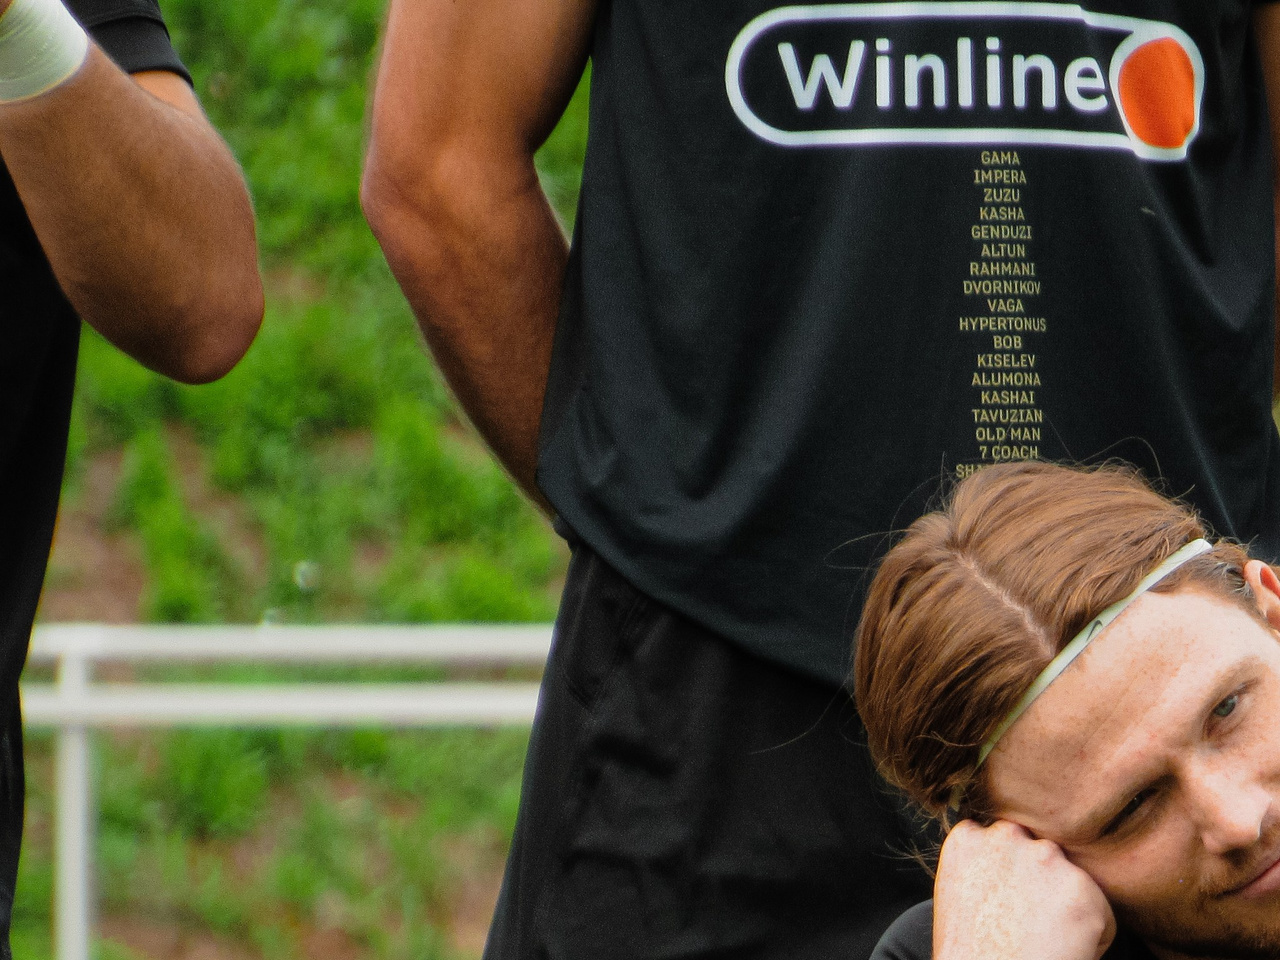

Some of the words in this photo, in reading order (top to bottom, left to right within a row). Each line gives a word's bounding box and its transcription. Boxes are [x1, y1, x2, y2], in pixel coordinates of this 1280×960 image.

[778, 37, 1109, 112] Winline
[981, 151, 1020, 165] GAMA
[974, 169, 1027, 184] IMPERA
[984, 188, 1020, 202] ZUZU
[980, 207, 1025, 221] KASHA
[971, 225, 1032, 239] GENDUZI
[981, 244, 1025, 258] ALTUN
[970, 262, 1036, 276] RAHMANI
[963, 280, 1041, 295] DVORNIKOV
[987, 299, 1024, 312] VAGA
[959, 317, 1046, 332] HYPERTONUS
[993, 335, 1022, 349] BOB
[977, 354, 1035, 368] KISELEV
[971, 372, 1041, 386] ALUMONA
[981, 391, 1035, 404] KASHAI
[971, 409, 1043, 423] TAVUZIAN
[975, 427, 1006, 441] OLD
[1010, 427, 1041, 441] MAN
[992, 446, 1038, 459] COACH
